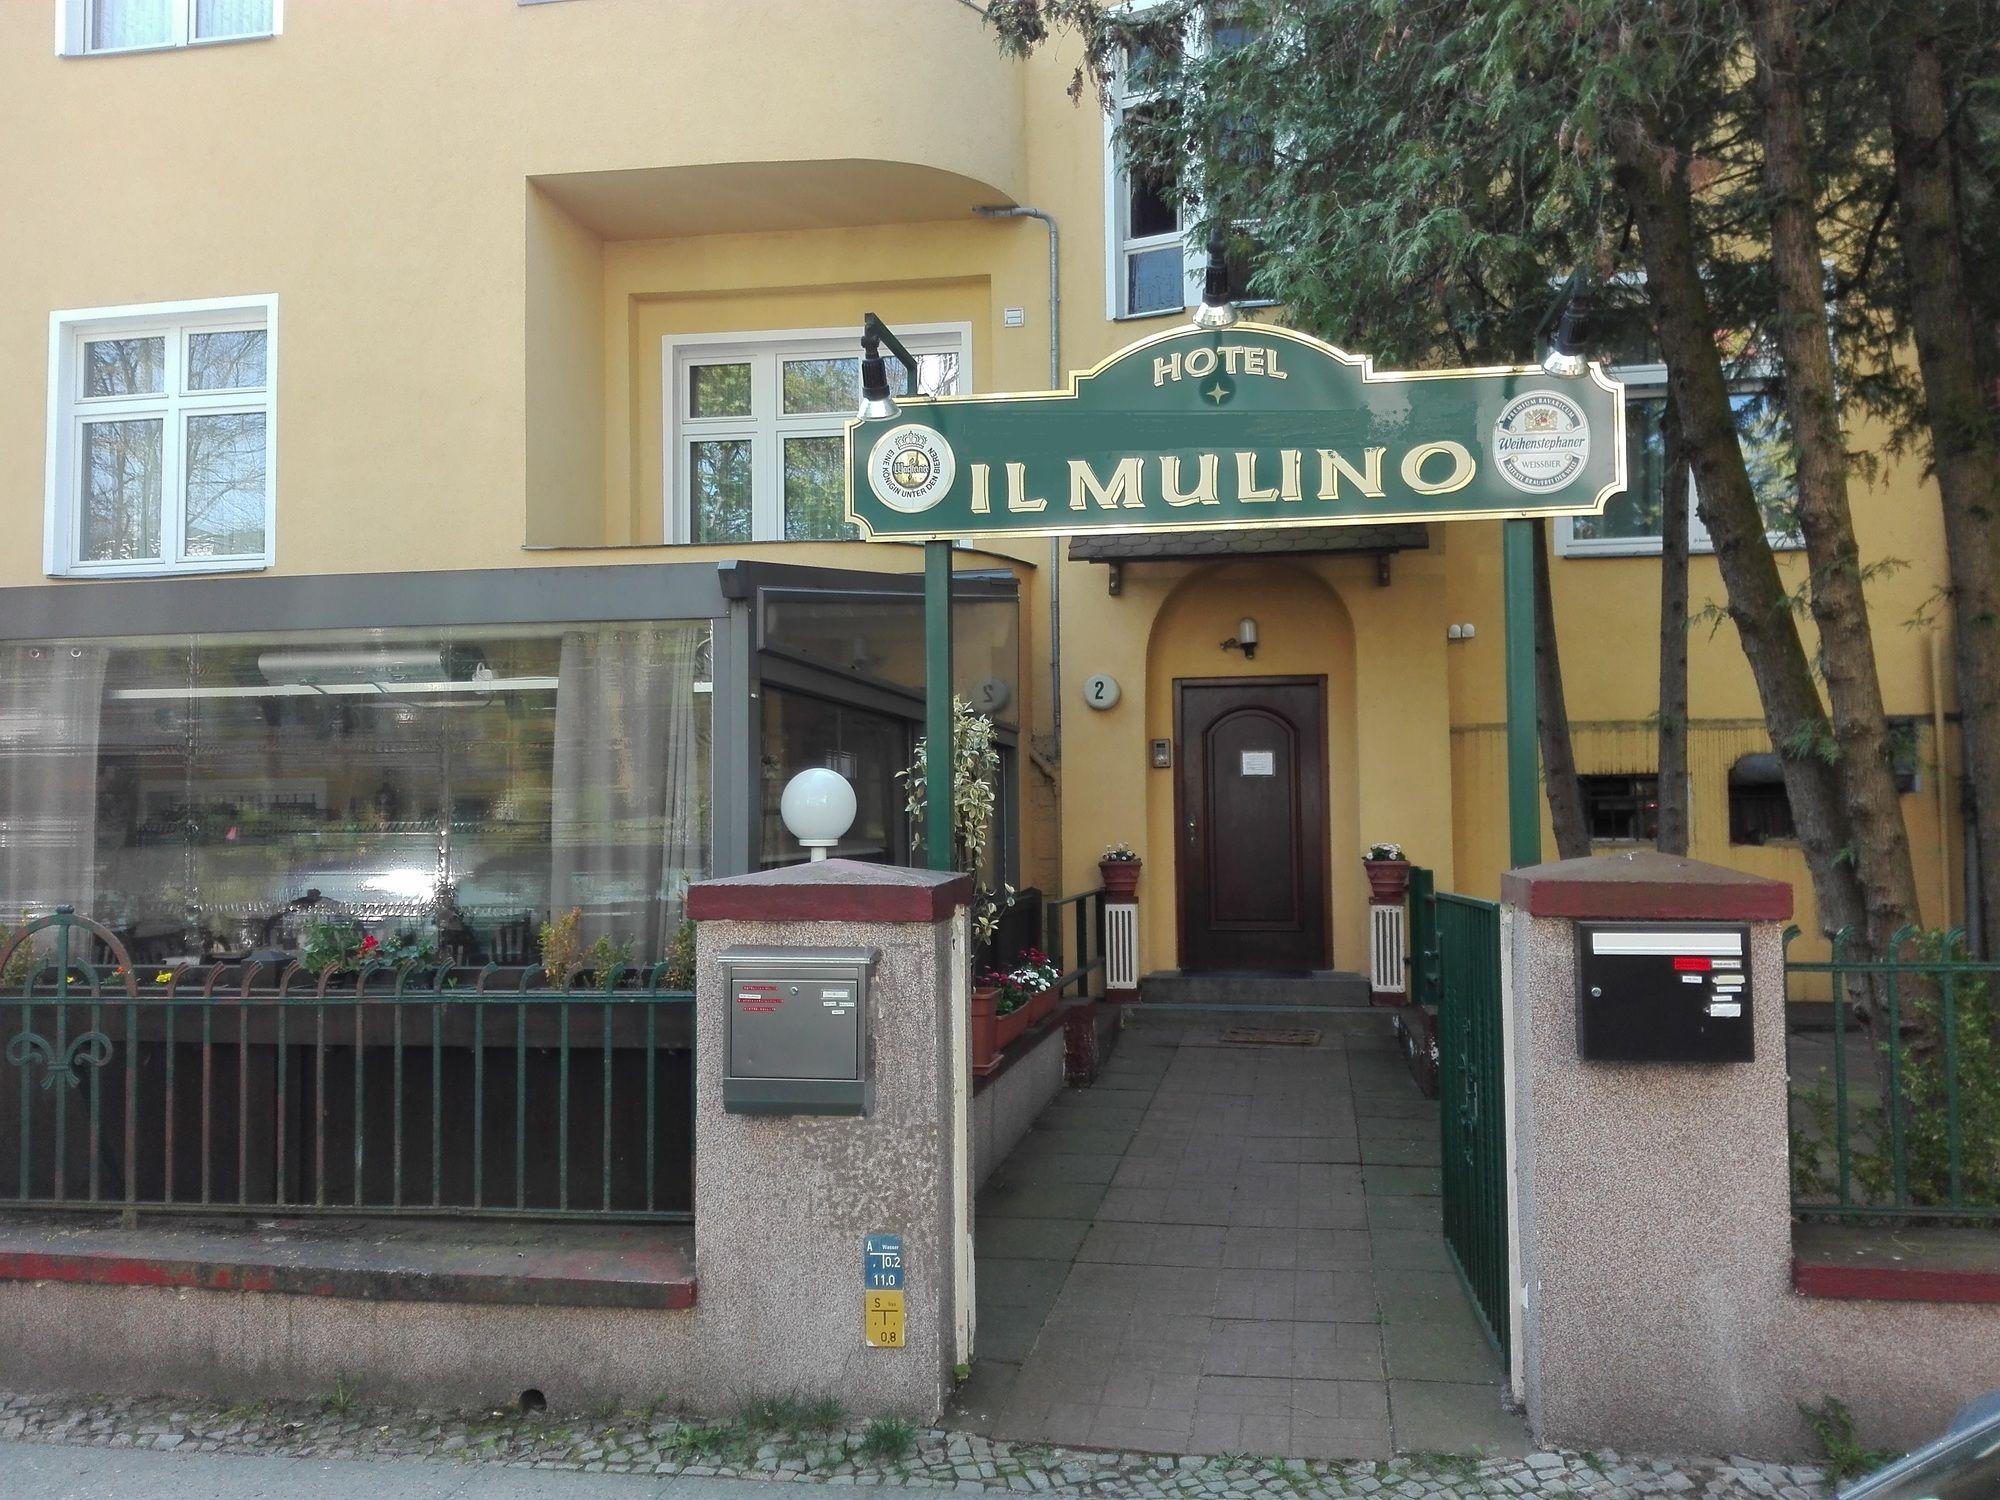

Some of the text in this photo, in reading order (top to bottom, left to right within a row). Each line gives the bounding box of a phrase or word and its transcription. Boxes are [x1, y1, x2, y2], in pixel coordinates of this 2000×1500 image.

[1153, 346, 1288, 388] HOTEL
[1507, 398, 1575, 420] PREMIUM BAVARICUM
[1498, 436, 1586, 451] Weihenstephaner
[883, 449, 895, 466] EINE
[927, 447, 940, 474] BIEREN
[1521, 460, 1562, 469] WEISSBIER
[925, 475, 940, 492] DEN
[970, 440, 1477, 515] IL MULINO
[901, 487, 927, 499] UNTER
[1094, 681, 1104, 700] 2
[866, 1240, 873, 1252] A
[874, 1298, 881, 1309] S
